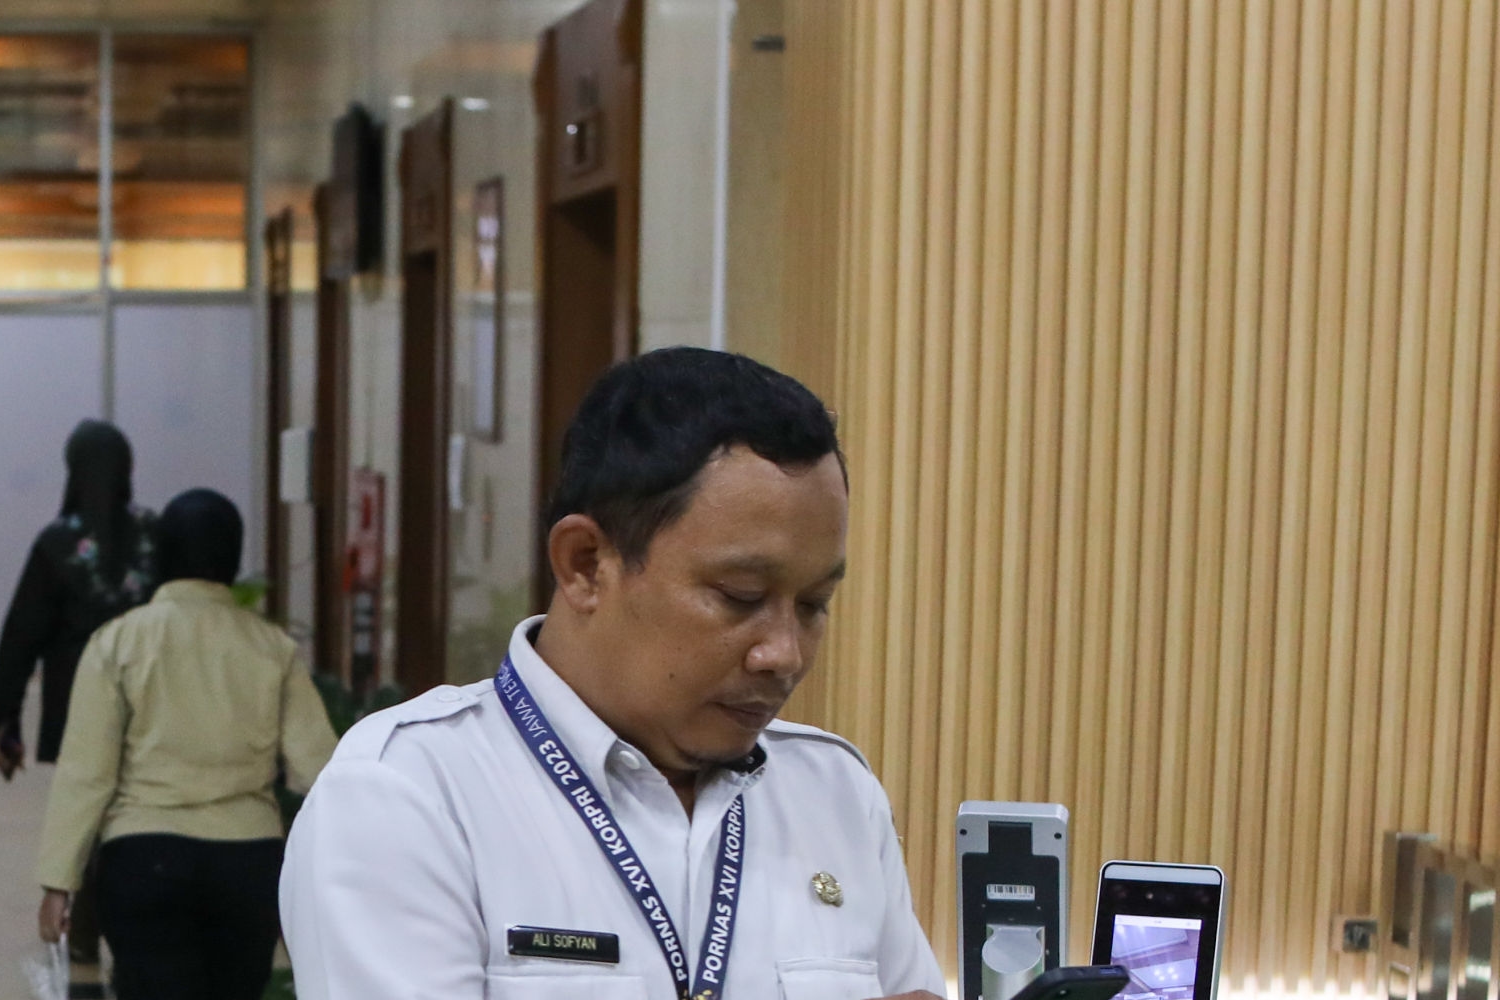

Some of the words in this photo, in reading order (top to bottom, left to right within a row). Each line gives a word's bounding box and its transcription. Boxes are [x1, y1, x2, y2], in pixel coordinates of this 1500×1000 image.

[498, 664, 521, 701] TENG
[514, 697, 547, 738] JAWA
[539, 740, 580, 785] 2023
[571, 786, 627, 855] KORPRI
[618, 857, 650, 892] XVI
[532, 933, 550, 947] ALI
[554, 934, 597, 950] SOFYAN
[642, 896, 687, 981] PORNAS
[702, 902, 732, 984] PORNAS
[718, 865, 738, 900] XVI
